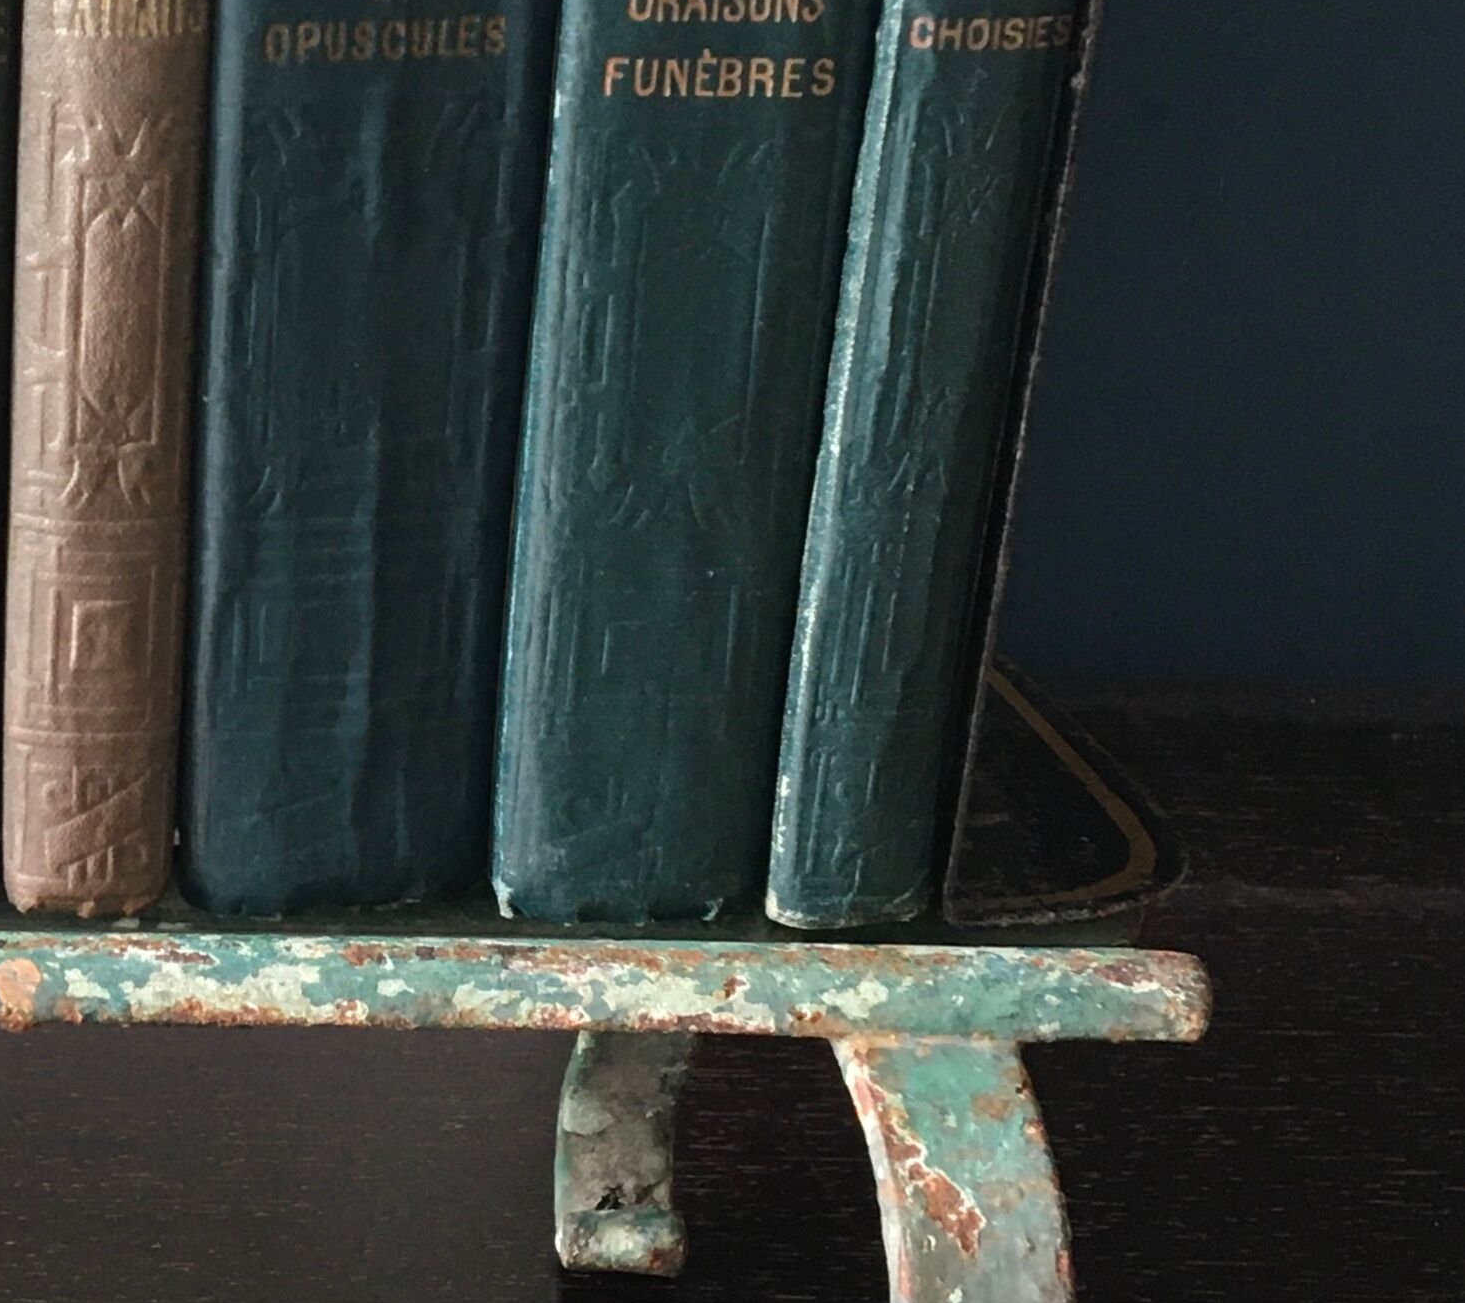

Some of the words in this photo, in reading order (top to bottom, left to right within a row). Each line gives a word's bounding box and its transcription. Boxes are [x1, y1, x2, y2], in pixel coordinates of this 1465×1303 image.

[264, 15, 507, 65] OPUSCULES
[909, 13, 1073, 51] CHOISIES
[604, 48, 835, 98] FUNÈBRES
